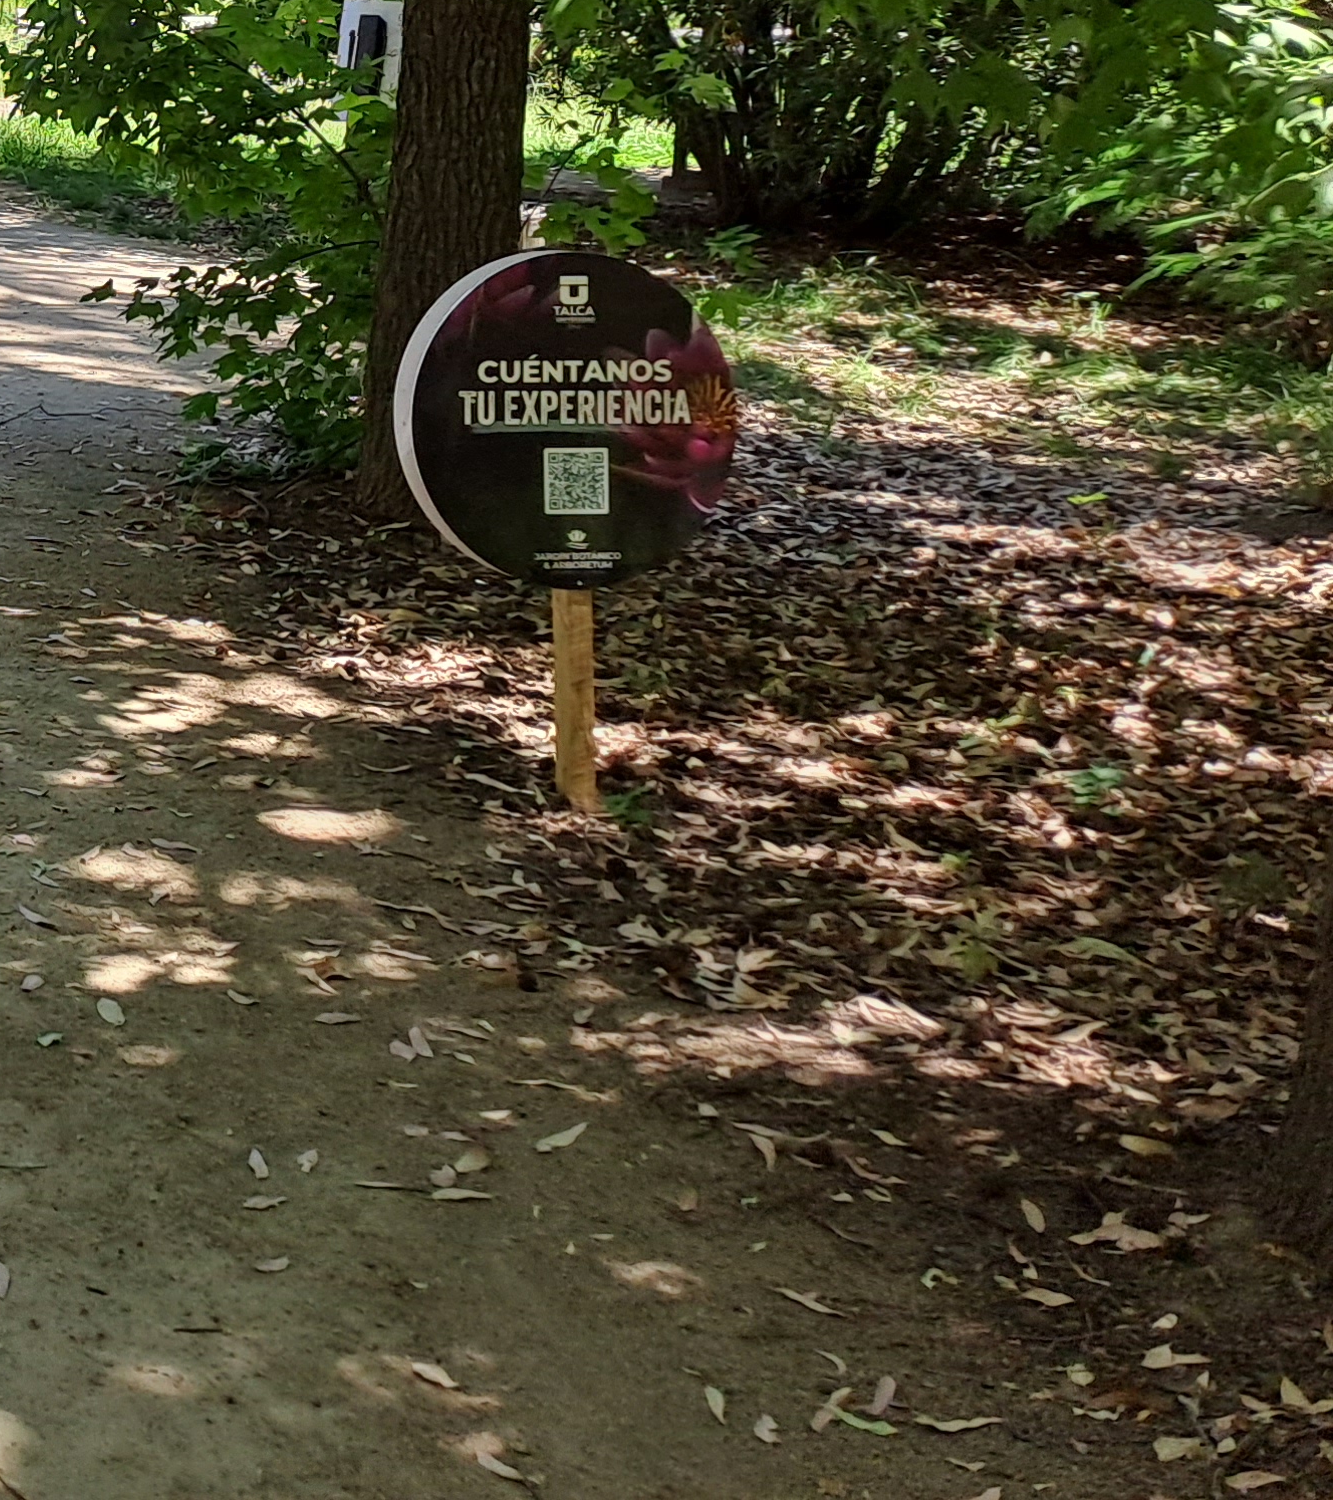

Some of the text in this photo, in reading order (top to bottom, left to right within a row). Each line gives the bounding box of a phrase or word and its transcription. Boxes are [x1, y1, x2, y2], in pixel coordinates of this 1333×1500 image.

[552, 305, 595, 316] TALCA
[477, 354, 673, 383] CUÉNTANOS
[458, 388, 692, 426] TU EXPERIENCIA
